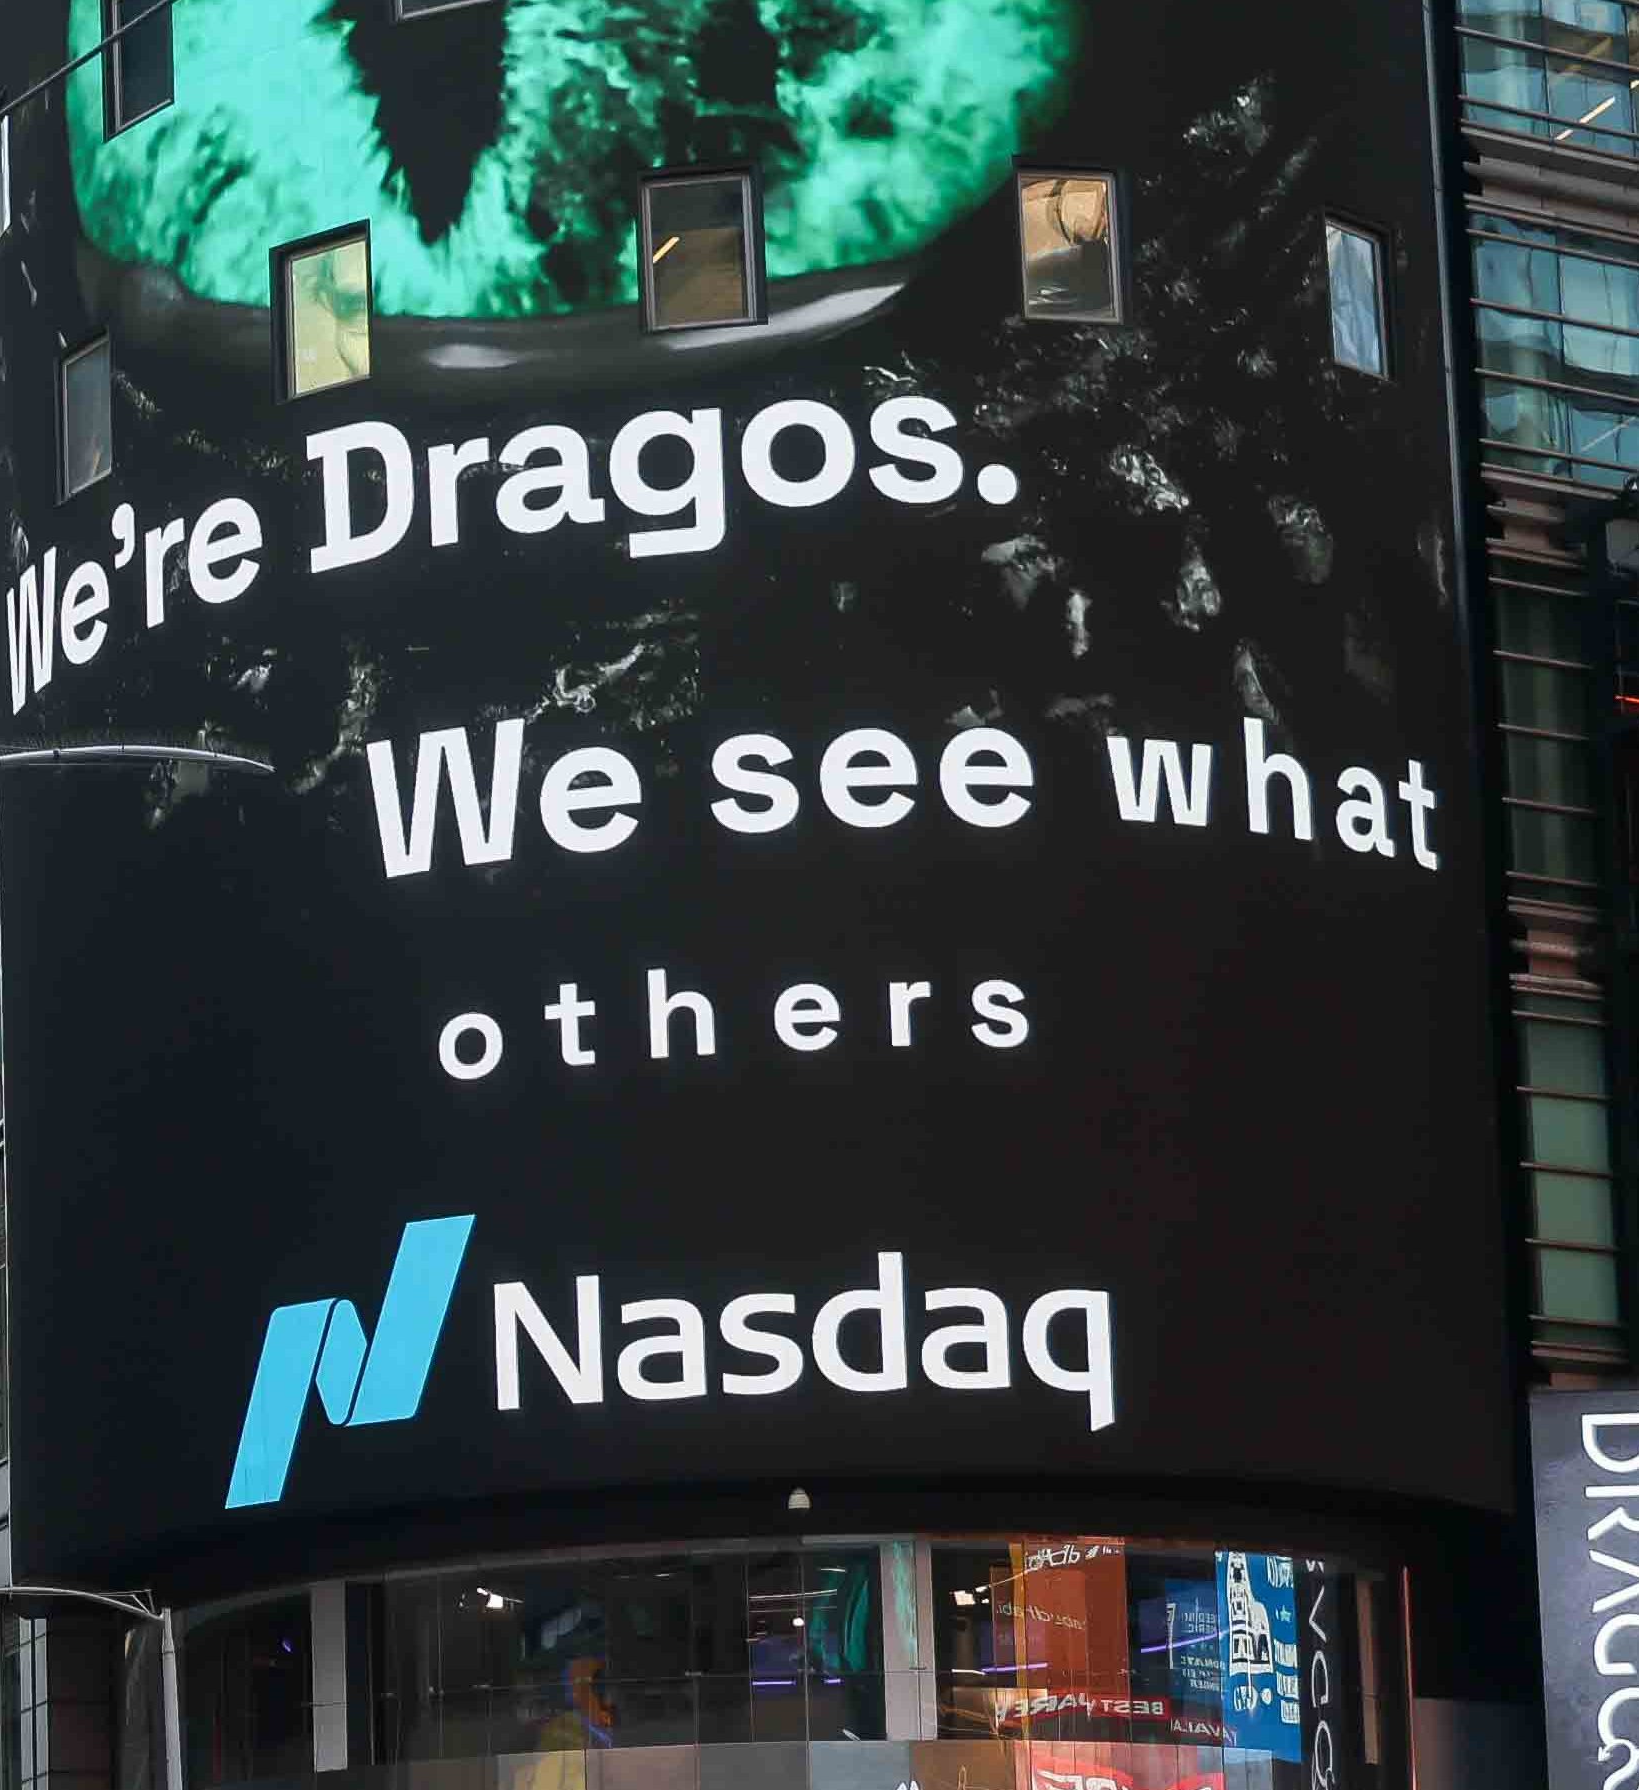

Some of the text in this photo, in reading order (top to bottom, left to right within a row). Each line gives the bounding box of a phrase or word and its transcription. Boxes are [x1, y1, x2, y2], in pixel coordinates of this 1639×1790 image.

[5, 396, 1019, 716] We're Dragos.
[365, 718, 1441, 879] We see what
[437, 967, 1031, 1080] others
[494, 1251, 1116, 1431] Nasdaq
